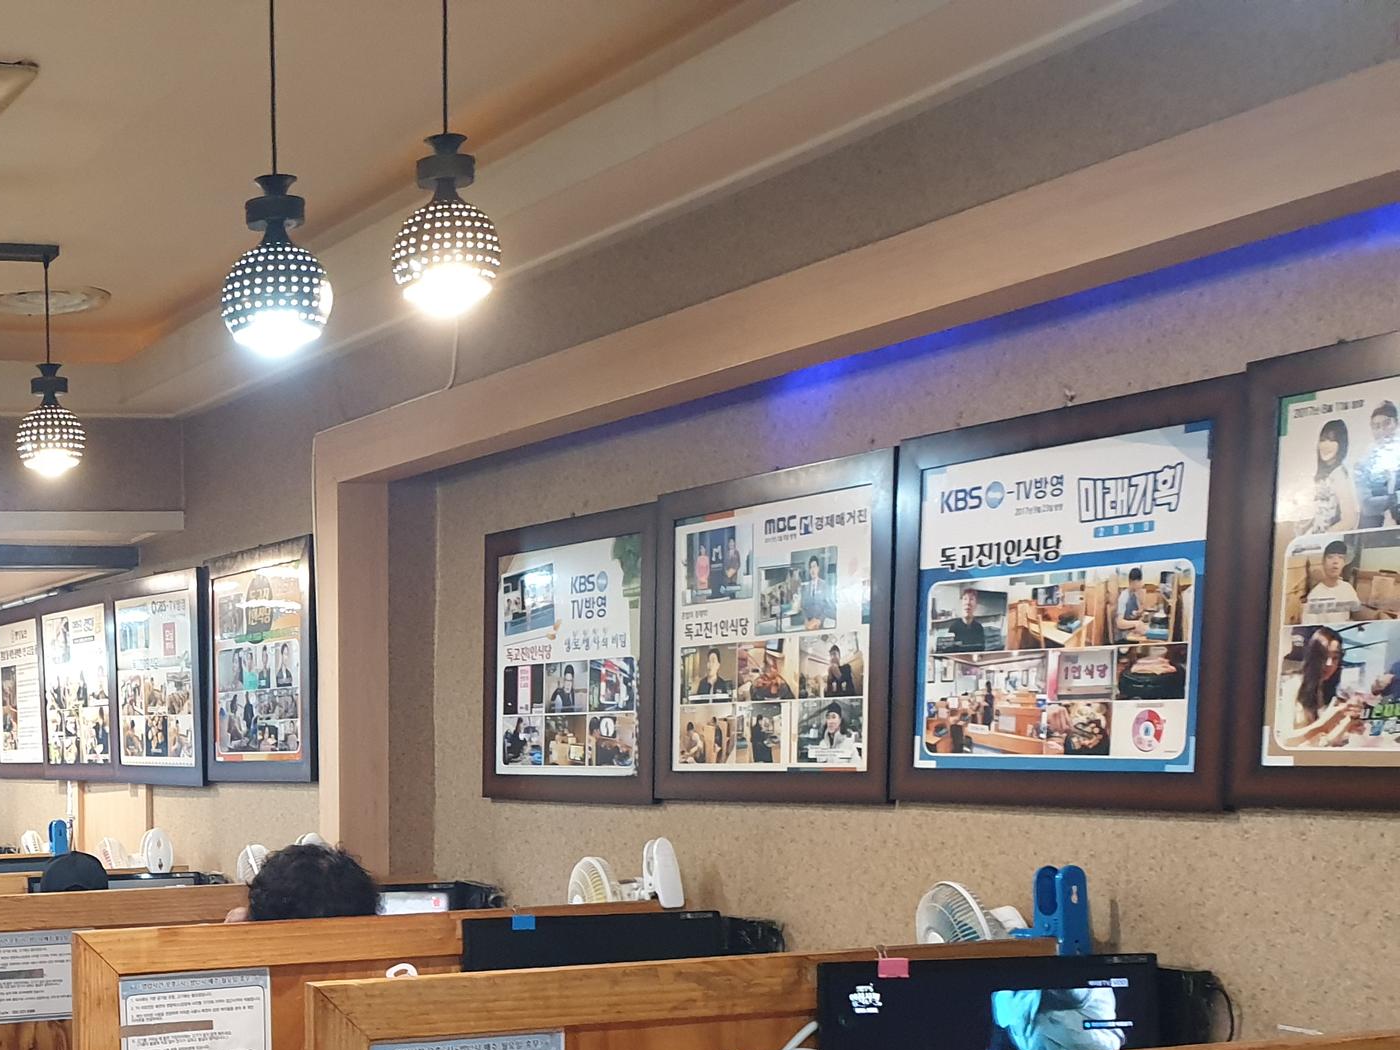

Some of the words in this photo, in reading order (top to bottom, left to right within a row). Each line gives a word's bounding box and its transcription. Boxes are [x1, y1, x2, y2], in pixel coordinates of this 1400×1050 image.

[940, 486, 982, 513] KBS
[1077, 461, 1185, 523] 미래기획
[570, 573, 596, 595] KBS
[570, 595, 607, 620] TV방영
